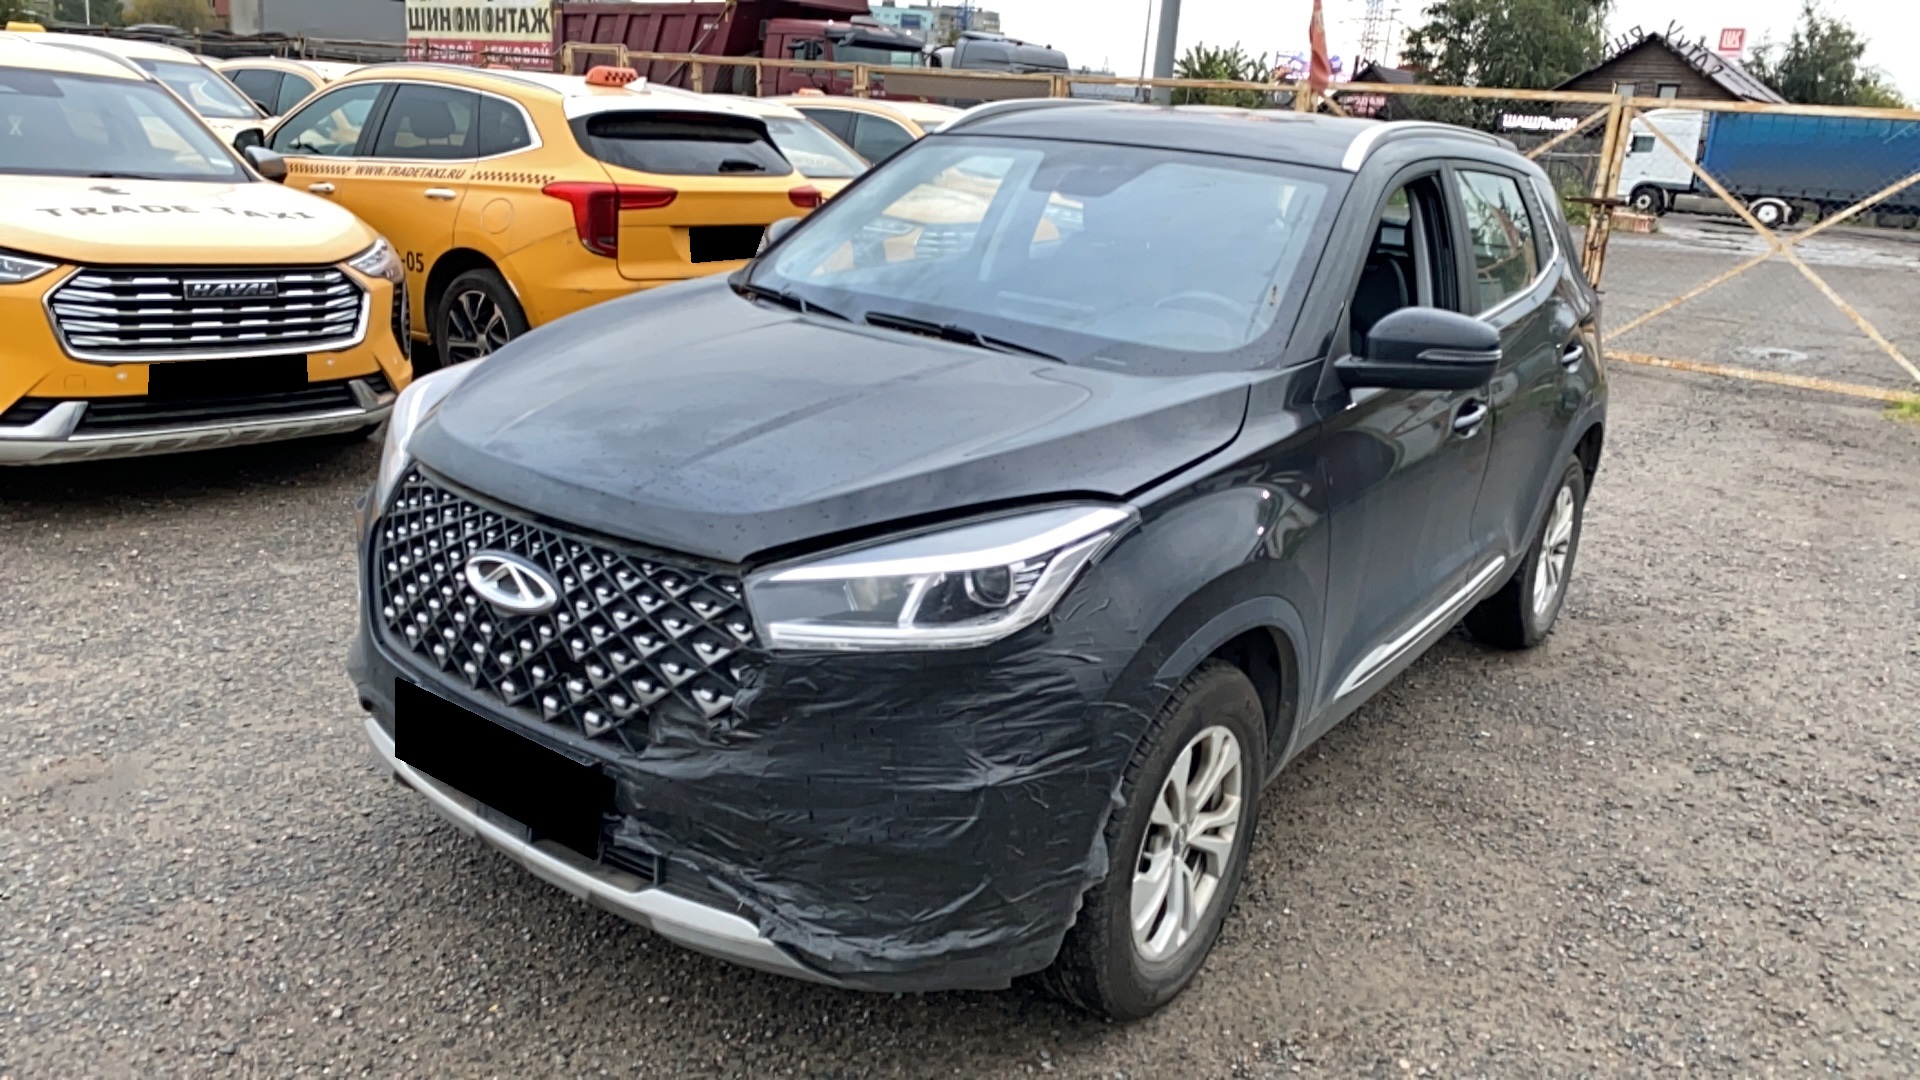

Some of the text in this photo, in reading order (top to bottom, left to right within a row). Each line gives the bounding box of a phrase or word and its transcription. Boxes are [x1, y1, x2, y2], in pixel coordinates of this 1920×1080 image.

[408, 7, 550, 33] ШИНОМОНТАЖ
[354, 165, 466, 180] WWW.TRADETAXI.RU
[35, 205, 315, 219] TRADE TAXI
[192, 283, 275, 297] HAVAL
